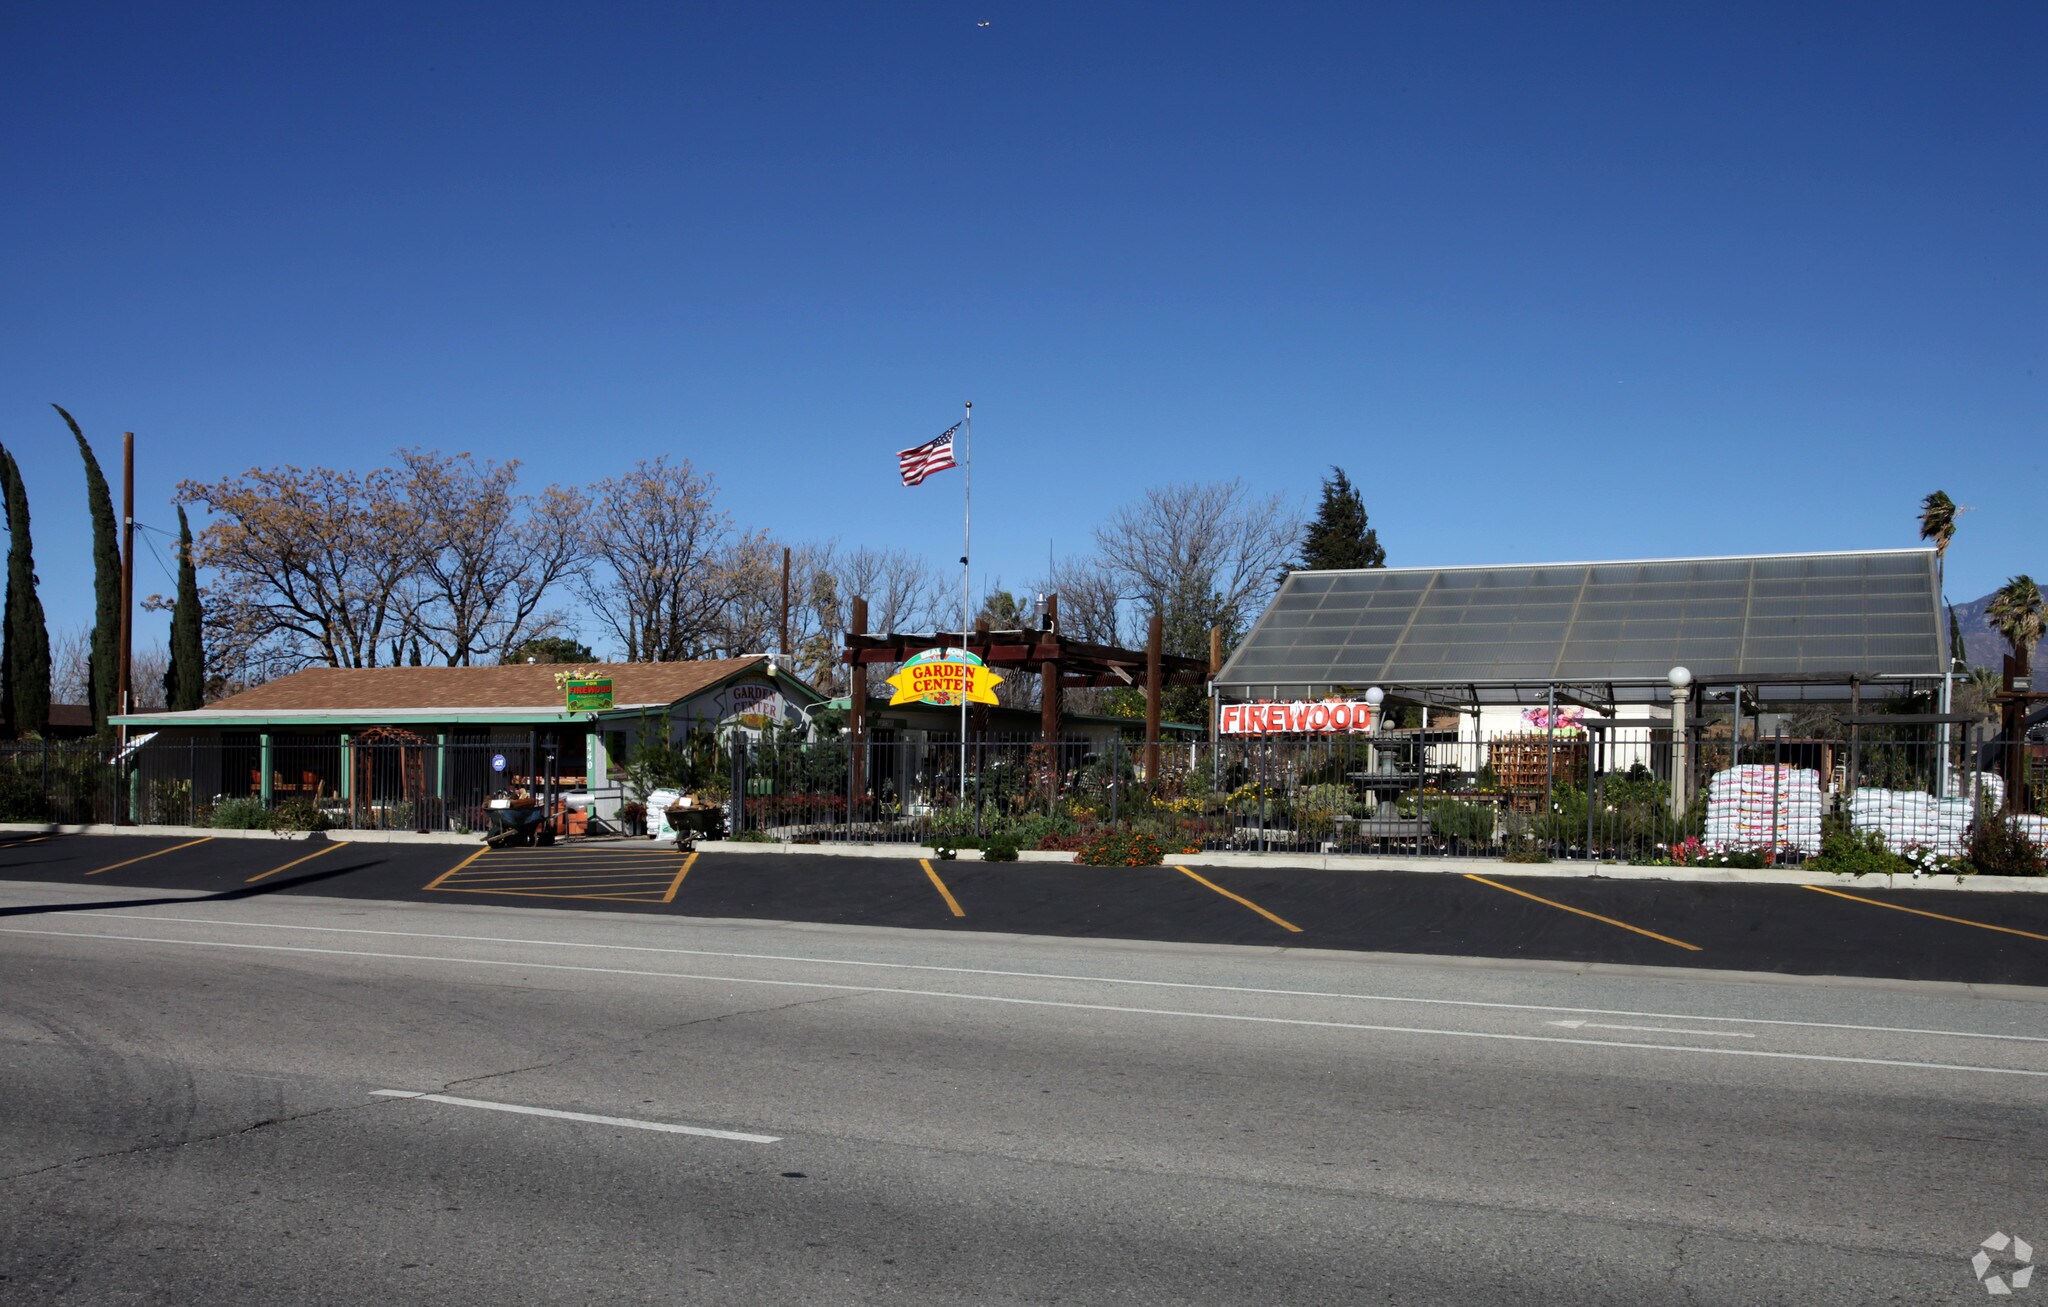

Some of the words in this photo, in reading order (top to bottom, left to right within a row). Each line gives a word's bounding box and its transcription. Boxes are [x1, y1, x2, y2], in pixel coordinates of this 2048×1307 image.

[912, 664, 975, 679] GARDEN
[569, 686, 611, 694] FIREWOOD
[913, 678, 974, 693] CENTER
[733, 687, 776, 702] GARDEN
[733, 701, 776, 717] CENTER
[1223, 704, 1370, 731] FIREWOOD
